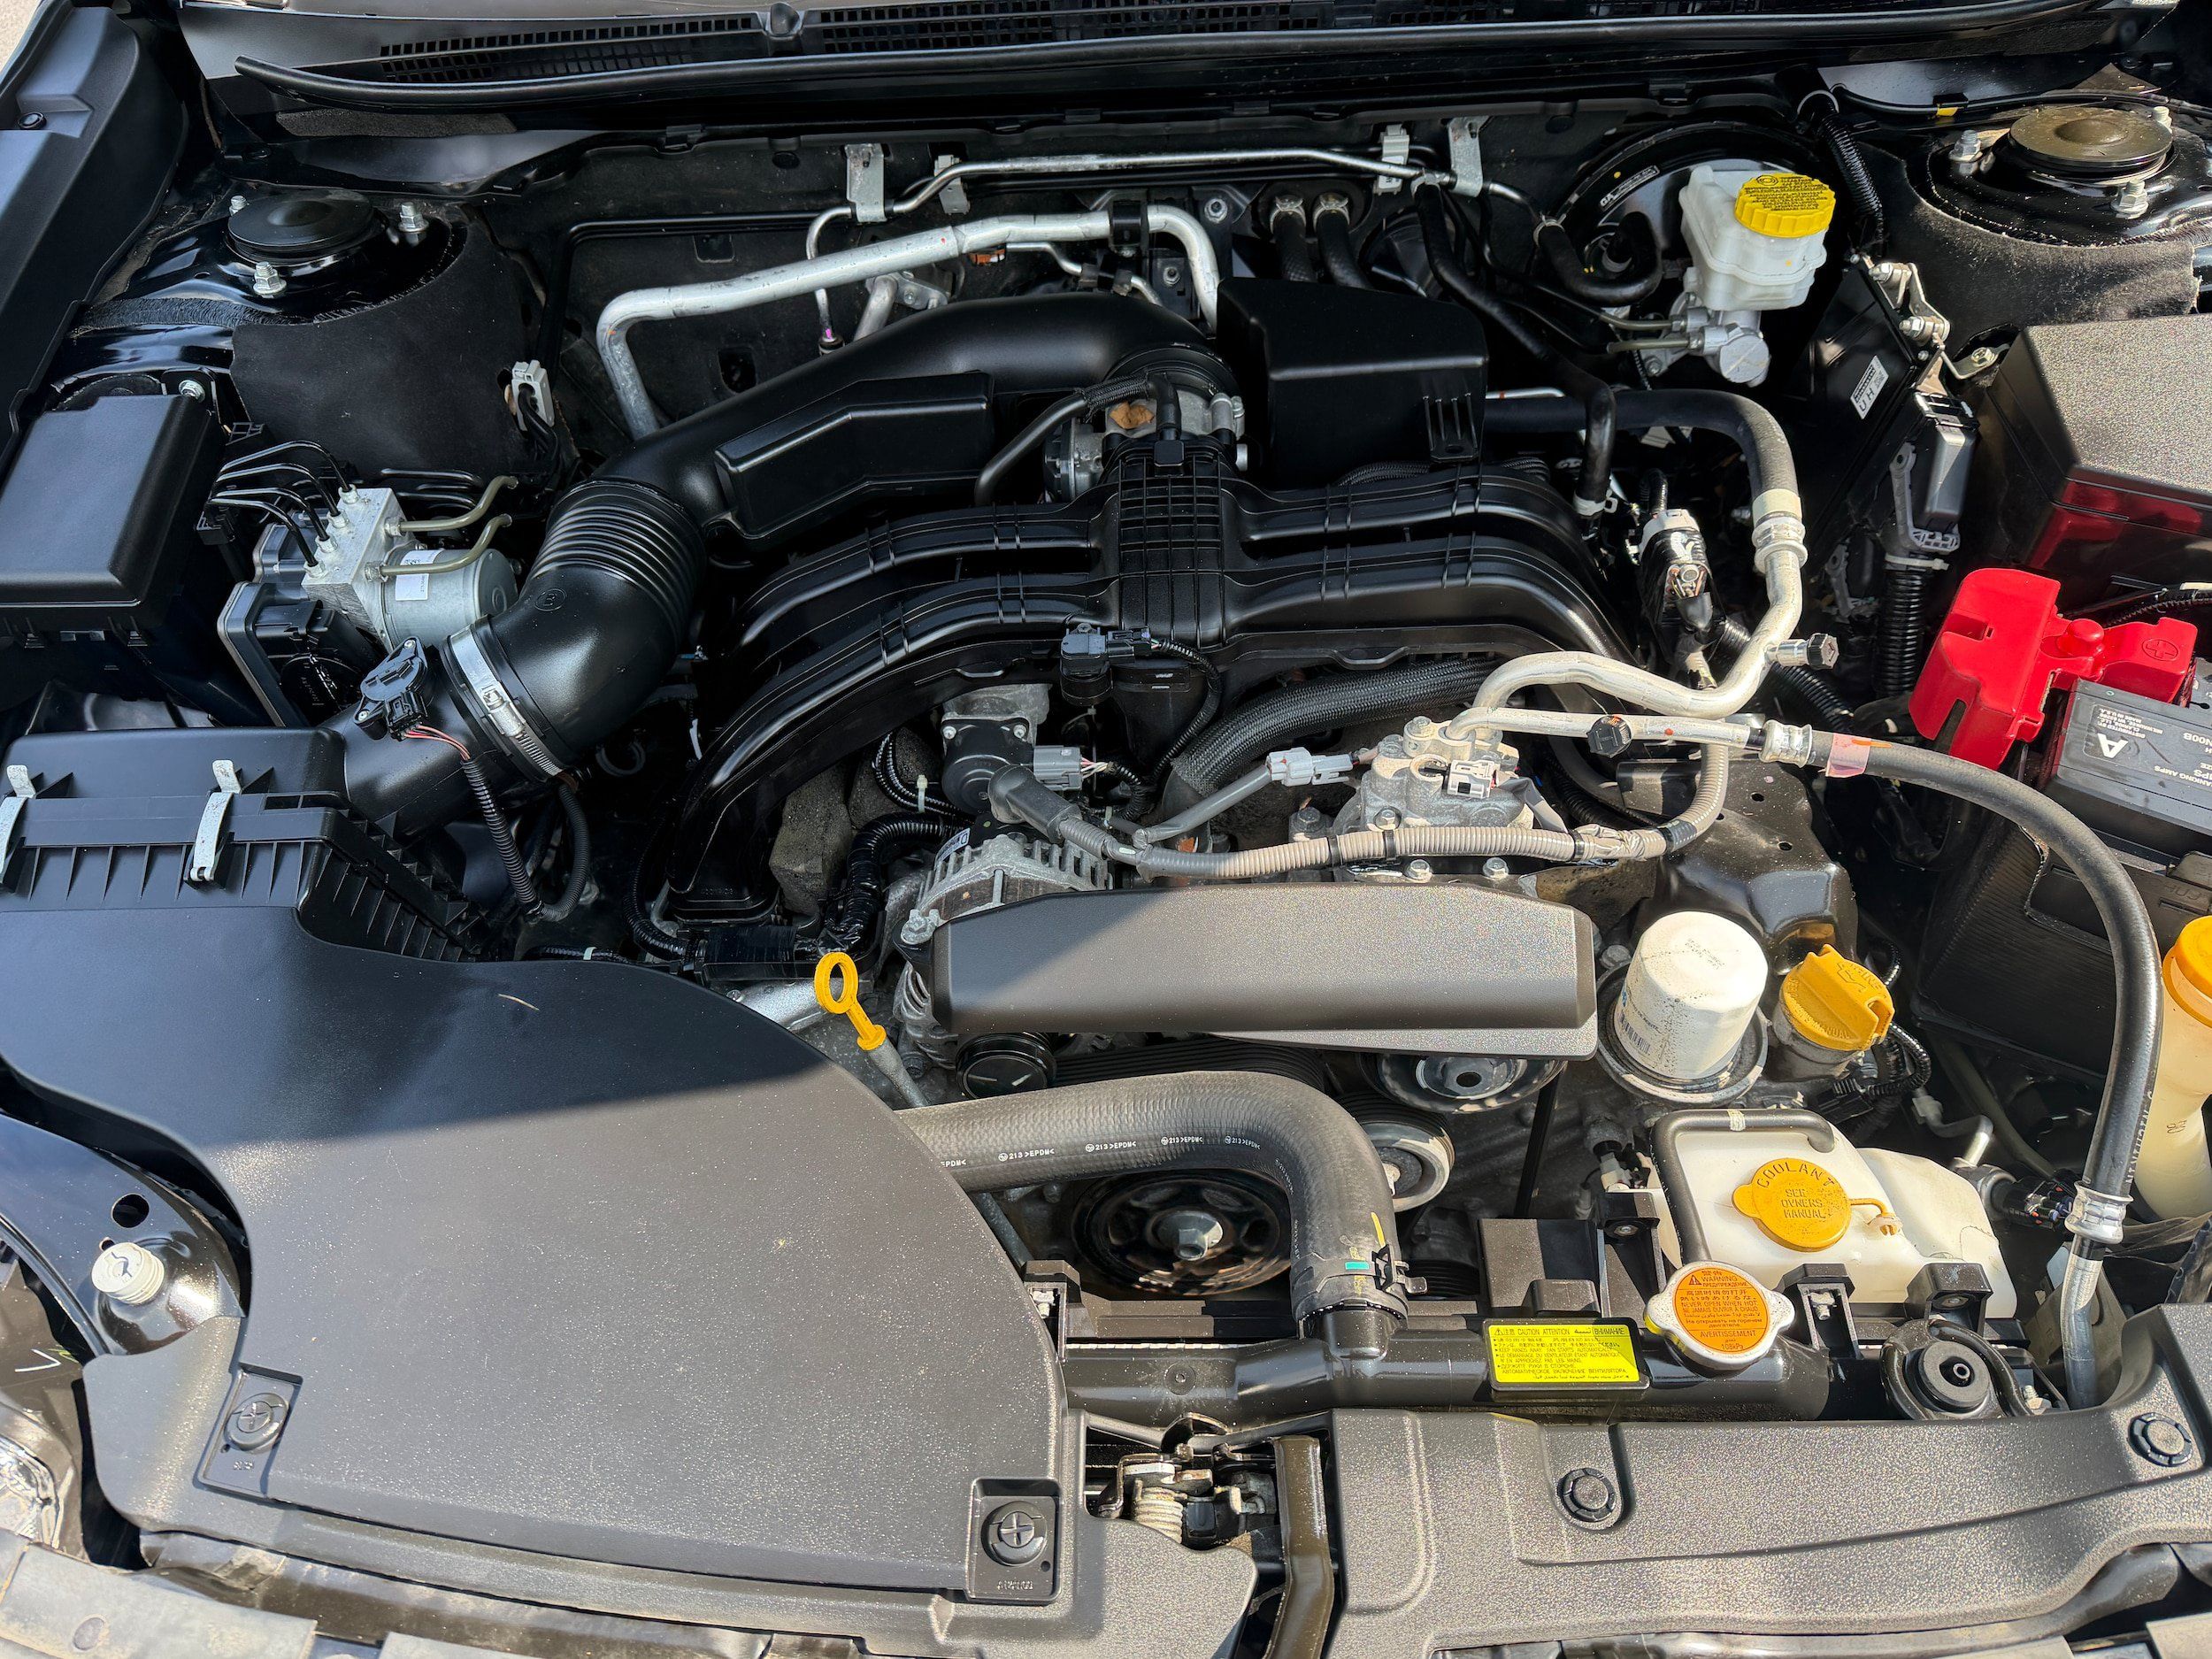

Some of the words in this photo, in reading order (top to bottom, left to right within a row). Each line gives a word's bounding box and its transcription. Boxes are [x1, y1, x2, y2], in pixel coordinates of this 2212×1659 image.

[2124, 715, 2142, 723] MADE
[2107, 724, 2146, 738] DISTRIBUTED
[2097, 733, 2128, 758] A
[2154, 765, 2178, 777] AMPS
[1757, 1162, 1835, 1188] COOLANT
[1786, 1188, 1806, 1198] SEE
[1784, 1209, 1826, 1219] MANUAL
